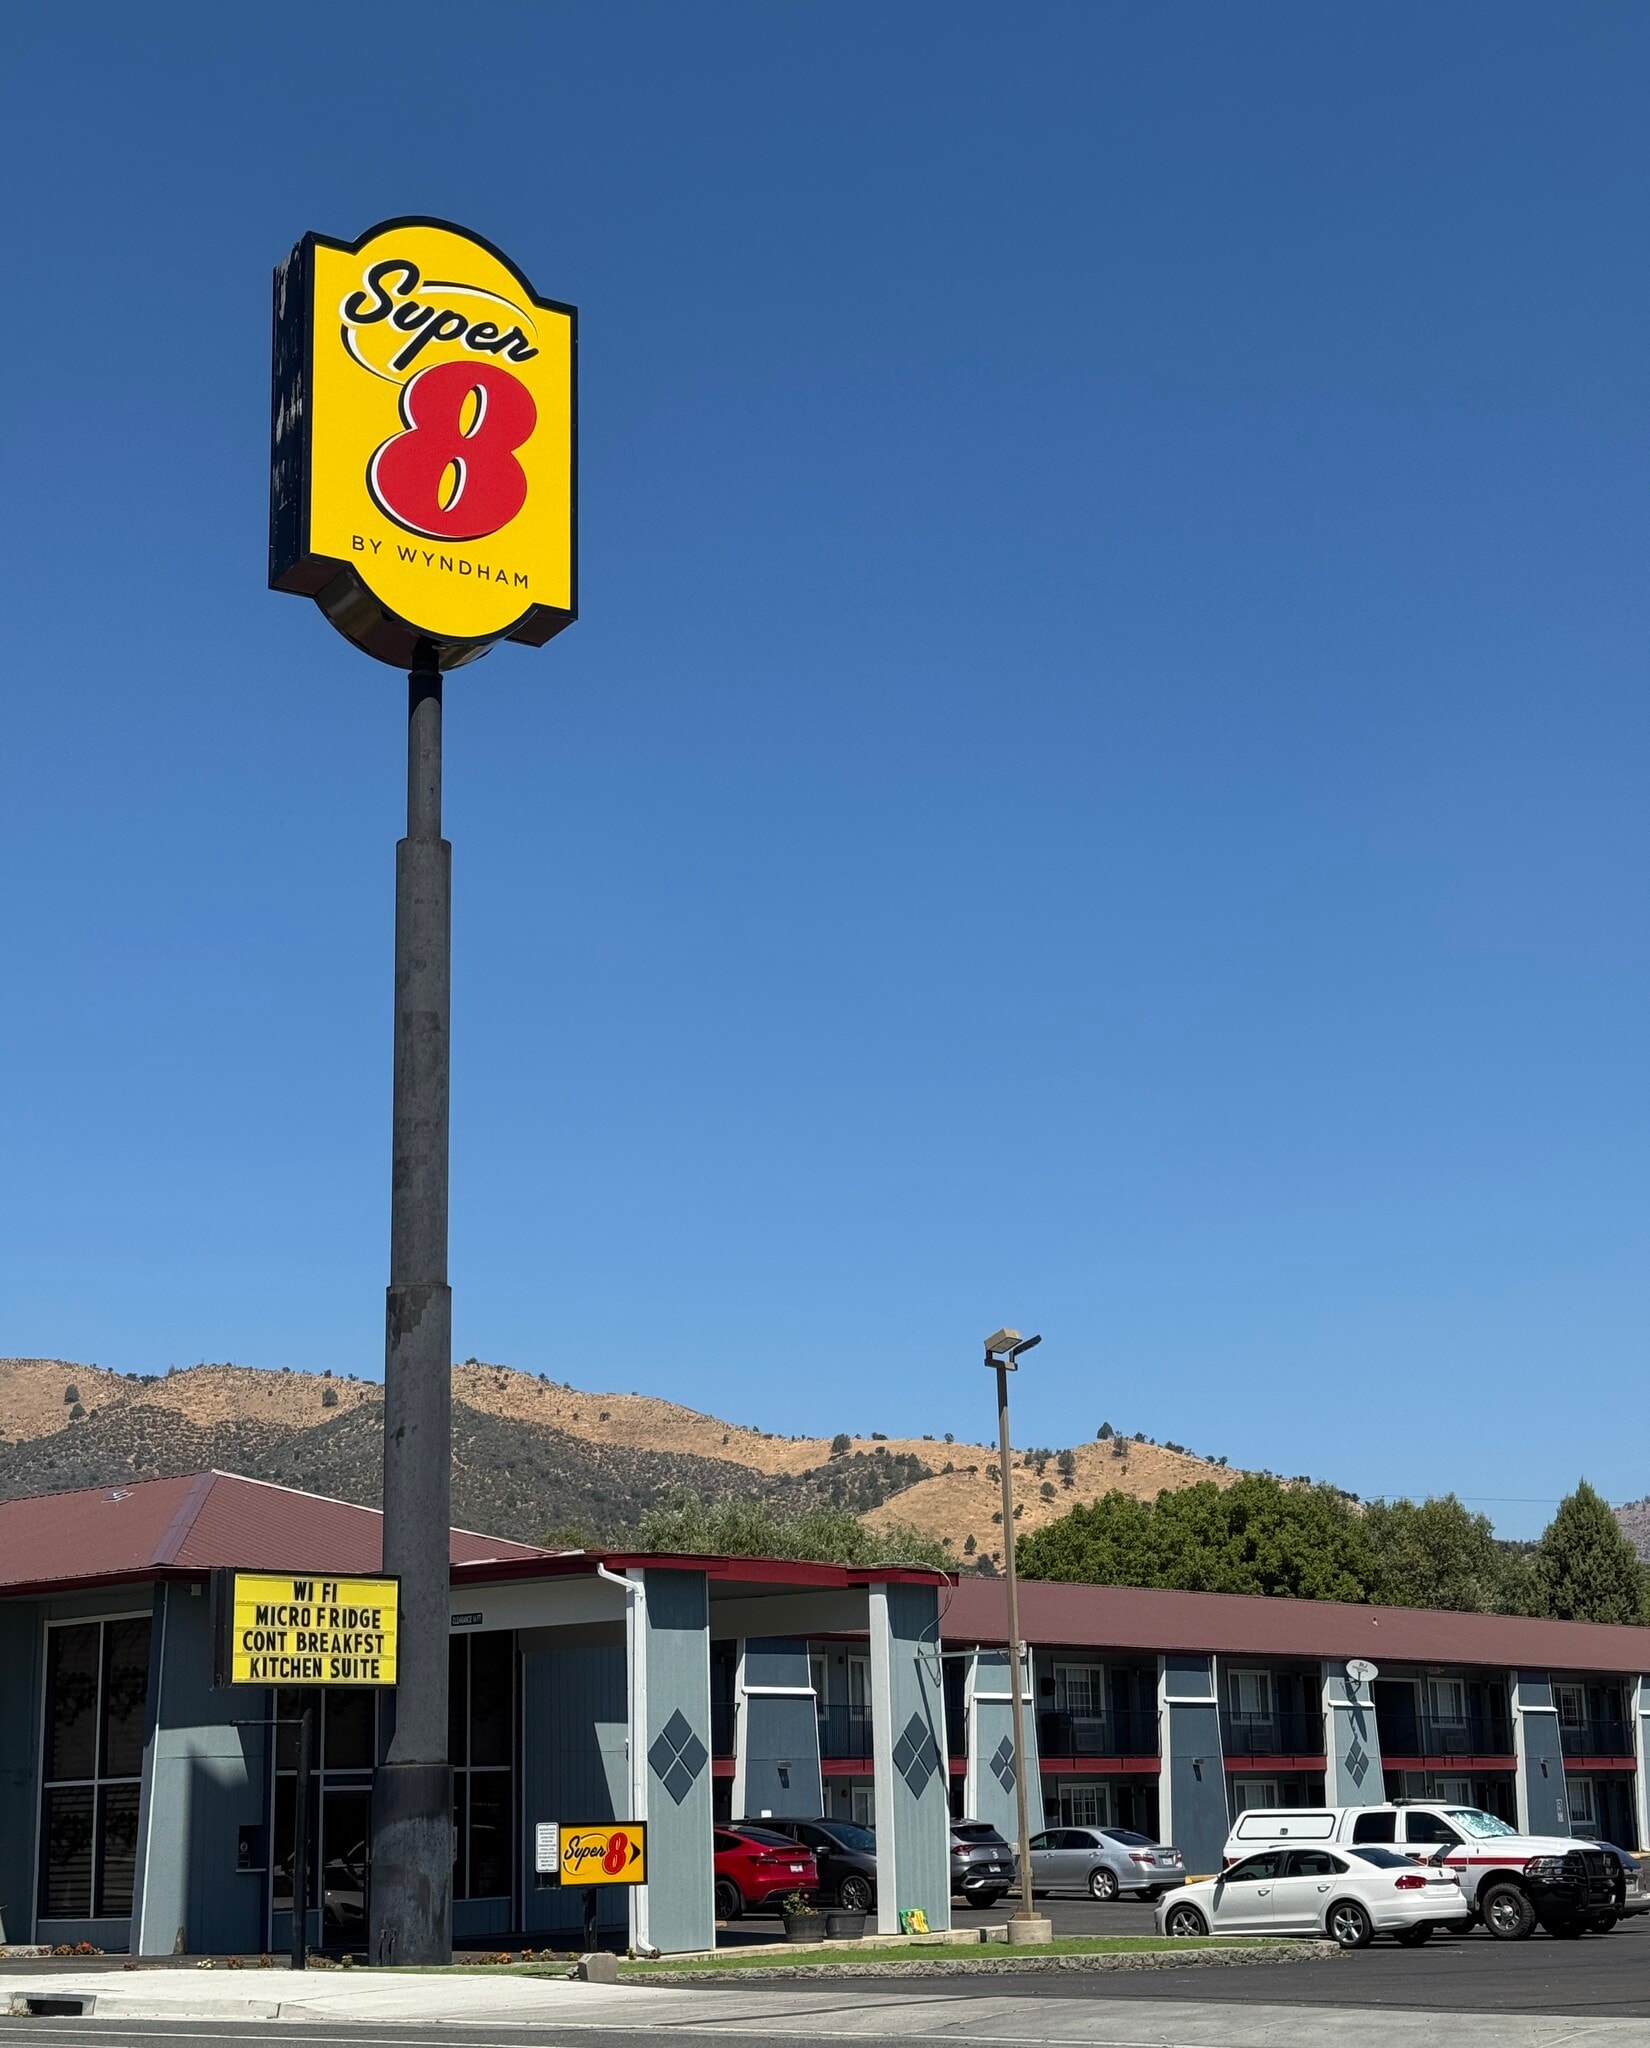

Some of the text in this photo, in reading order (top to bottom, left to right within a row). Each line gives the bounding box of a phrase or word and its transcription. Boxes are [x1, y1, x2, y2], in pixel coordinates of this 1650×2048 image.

[343, 258, 539, 371] Super
[366, 360, 537, 542] 8
[352, 535, 530, 589] BY WYNDHAM
[293, 1581, 337, 1603] WI FI
[243, 1631, 384, 1654] CONT BREAKFST
[250, 1657, 380, 1679] KITCHEN SUITE
[564, 1835, 606, 1871] Super
[602, 1832, 628, 1875] 8
